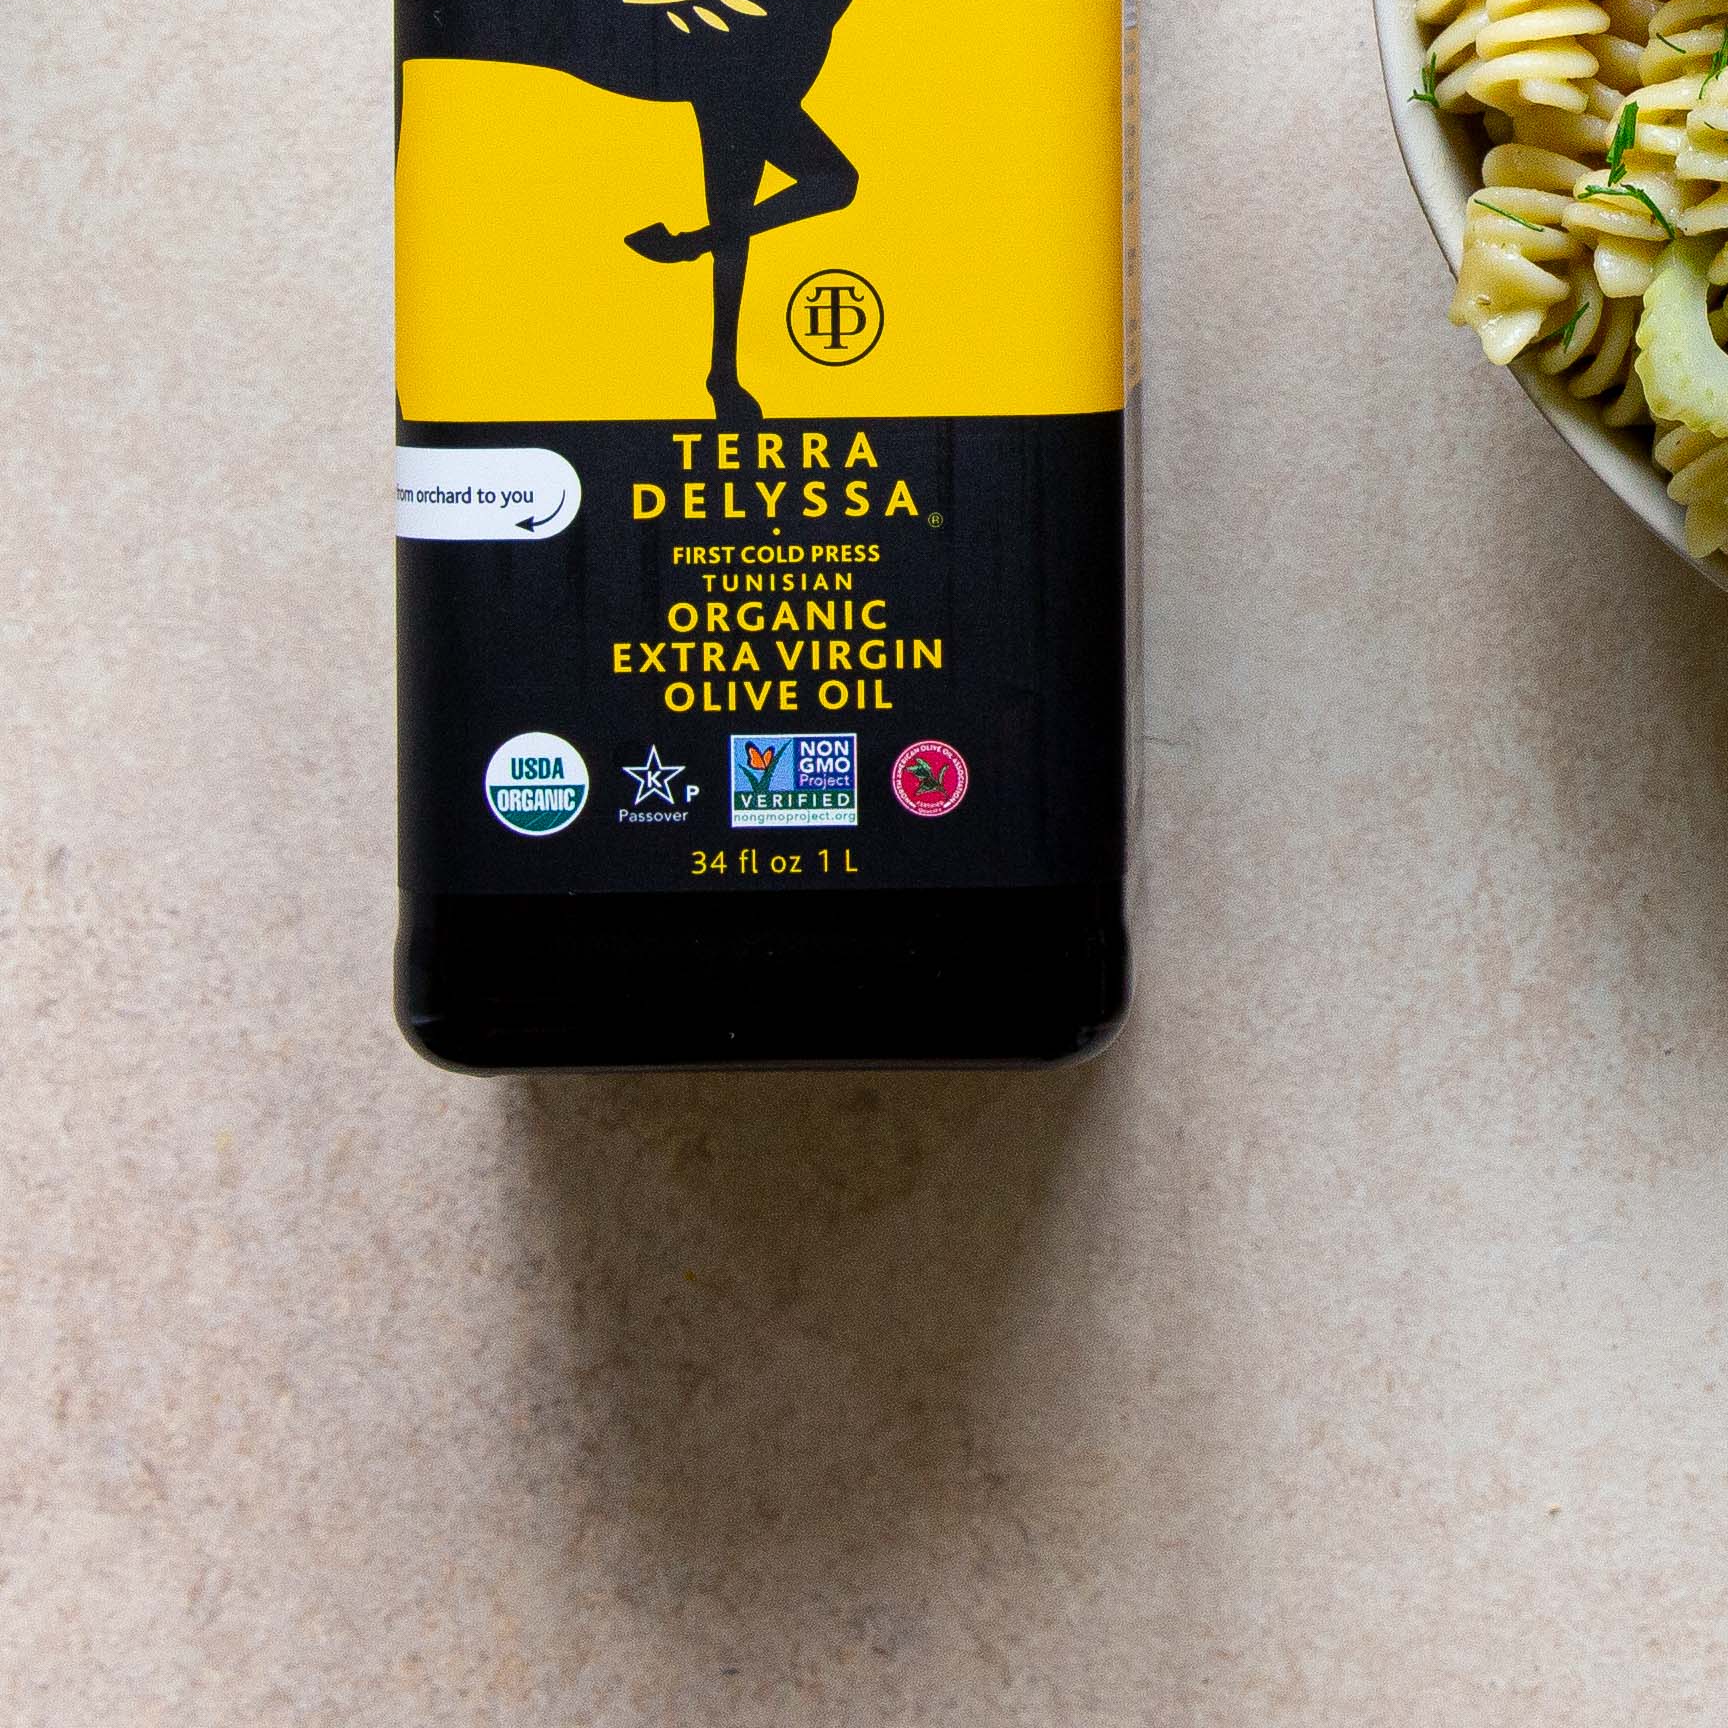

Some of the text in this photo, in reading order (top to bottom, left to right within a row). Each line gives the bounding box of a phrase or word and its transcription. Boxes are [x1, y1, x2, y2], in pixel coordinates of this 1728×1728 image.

[671, 431, 879, 471] TERRA
[396, 481, 534, 509] rom orchard to you
[632, 479, 919, 520] DELYSSA
[673, 544, 881, 564] FIRST COLD PRESS
[702, 572, 853, 593] TUNISIAN
[667, 599, 888, 633] ORGANIC
[613, 638, 943, 674] EXTRA VIRGIN
[664, 678, 893, 712] OLIVE OIL
[799, 740, 850, 757] NON
[510, 757, 565, 780] USDA
[799, 757, 852, 774] GMO
[647, 770, 662, 789] K
[799, 773, 851, 791] Project
[497, 788, 577, 813] ORGANIC
[686, 784, 700, 803] P
[740, 792, 852, 809] VERIFIED
[618, 808, 689, 824] Passover
[733, 811, 857, 825] nongmoproject.org
[690, 848, 859, 875] 34 fl oz 1 L
